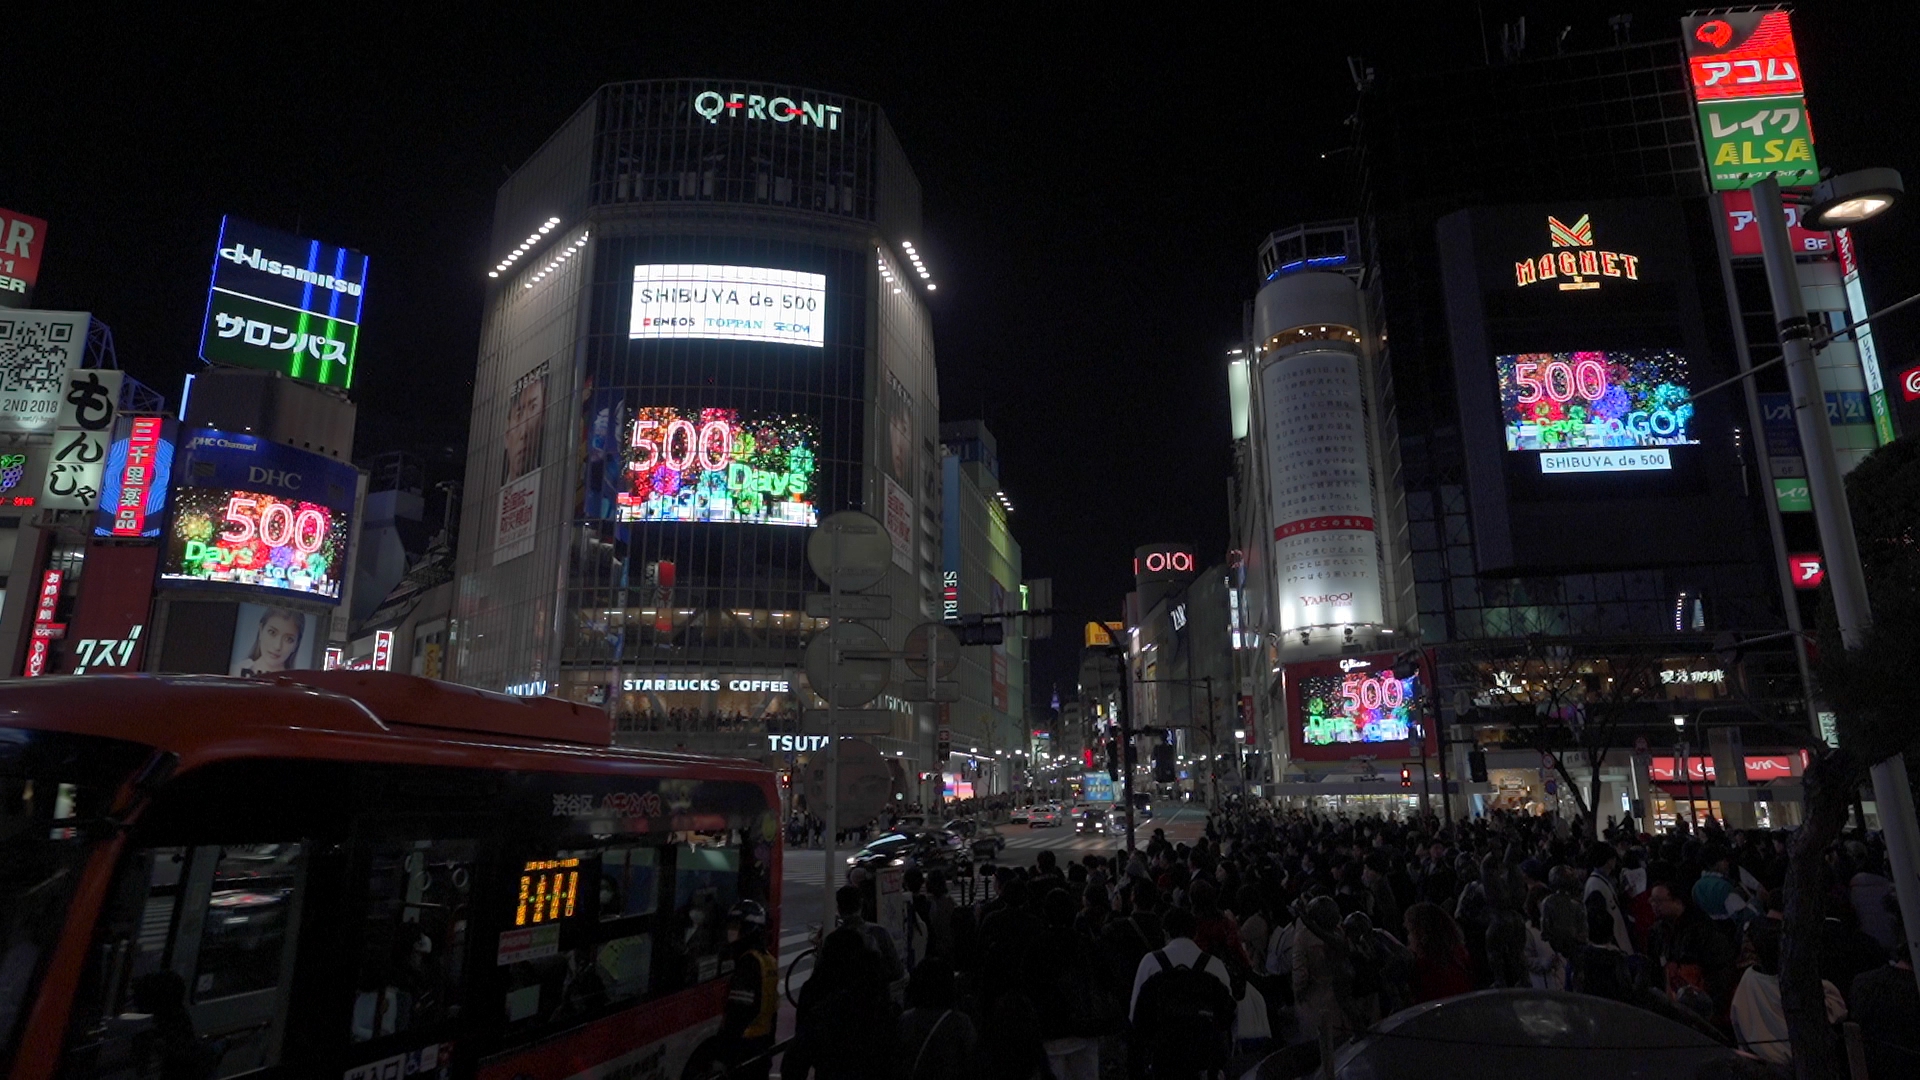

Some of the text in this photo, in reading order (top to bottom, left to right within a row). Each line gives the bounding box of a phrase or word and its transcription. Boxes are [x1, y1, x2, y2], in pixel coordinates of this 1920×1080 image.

[1700, 58, 1796, 86] アコム
[694, 91, 842, 131] QFRONT
[1708, 107, 1801, 138] レイク
[1713, 138, 1811, 166] ALSA
[1804, 237, 1828, 250] 8F
[219, 243, 362, 297] Hisamitsu
[1515, 250, 1640, 287] MAGNET
[640, 287, 817, 311] SHIBUYA de 500
[652, 317, 695, 327] ENEOS
[706, 318, 763, 329] TOPPAN
[215, 312, 347, 365] サロンパス
[1515, 361, 1605, 403] 500
[3, 398, 58, 413] 2ND 2018
[1591, 409, 1687, 437] to GO!
[50, 373, 113, 507] もんじゃ
[216, 438, 257, 451] Channel
[629, 420, 730, 471] 500
[1545, 454, 1665, 469] SHIBUYA de 500
[115, 422, 155, 530] 三千里薬品
[247, 465, 303, 490] DHC
[728, 463, 808, 496] Days
[1776, 487, 1809, 498] レイク
[219, 496, 325, 554] 500
[184, 539, 254, 566] Days
[1146, 551, 1194, 572] OIOI
[1799, 562, 1820, 581] ア
[943, 570, 958, 620] SEIBU
[1300, 592, 1353, 607] YAHOO!
[73, 624, 143, 675] クスリ
[623, 679, 789, 693] STARBUCKS COFFEE
[1341, 677, 1403, 711] 500
[552, 794, 594, 816] 渋谷区
